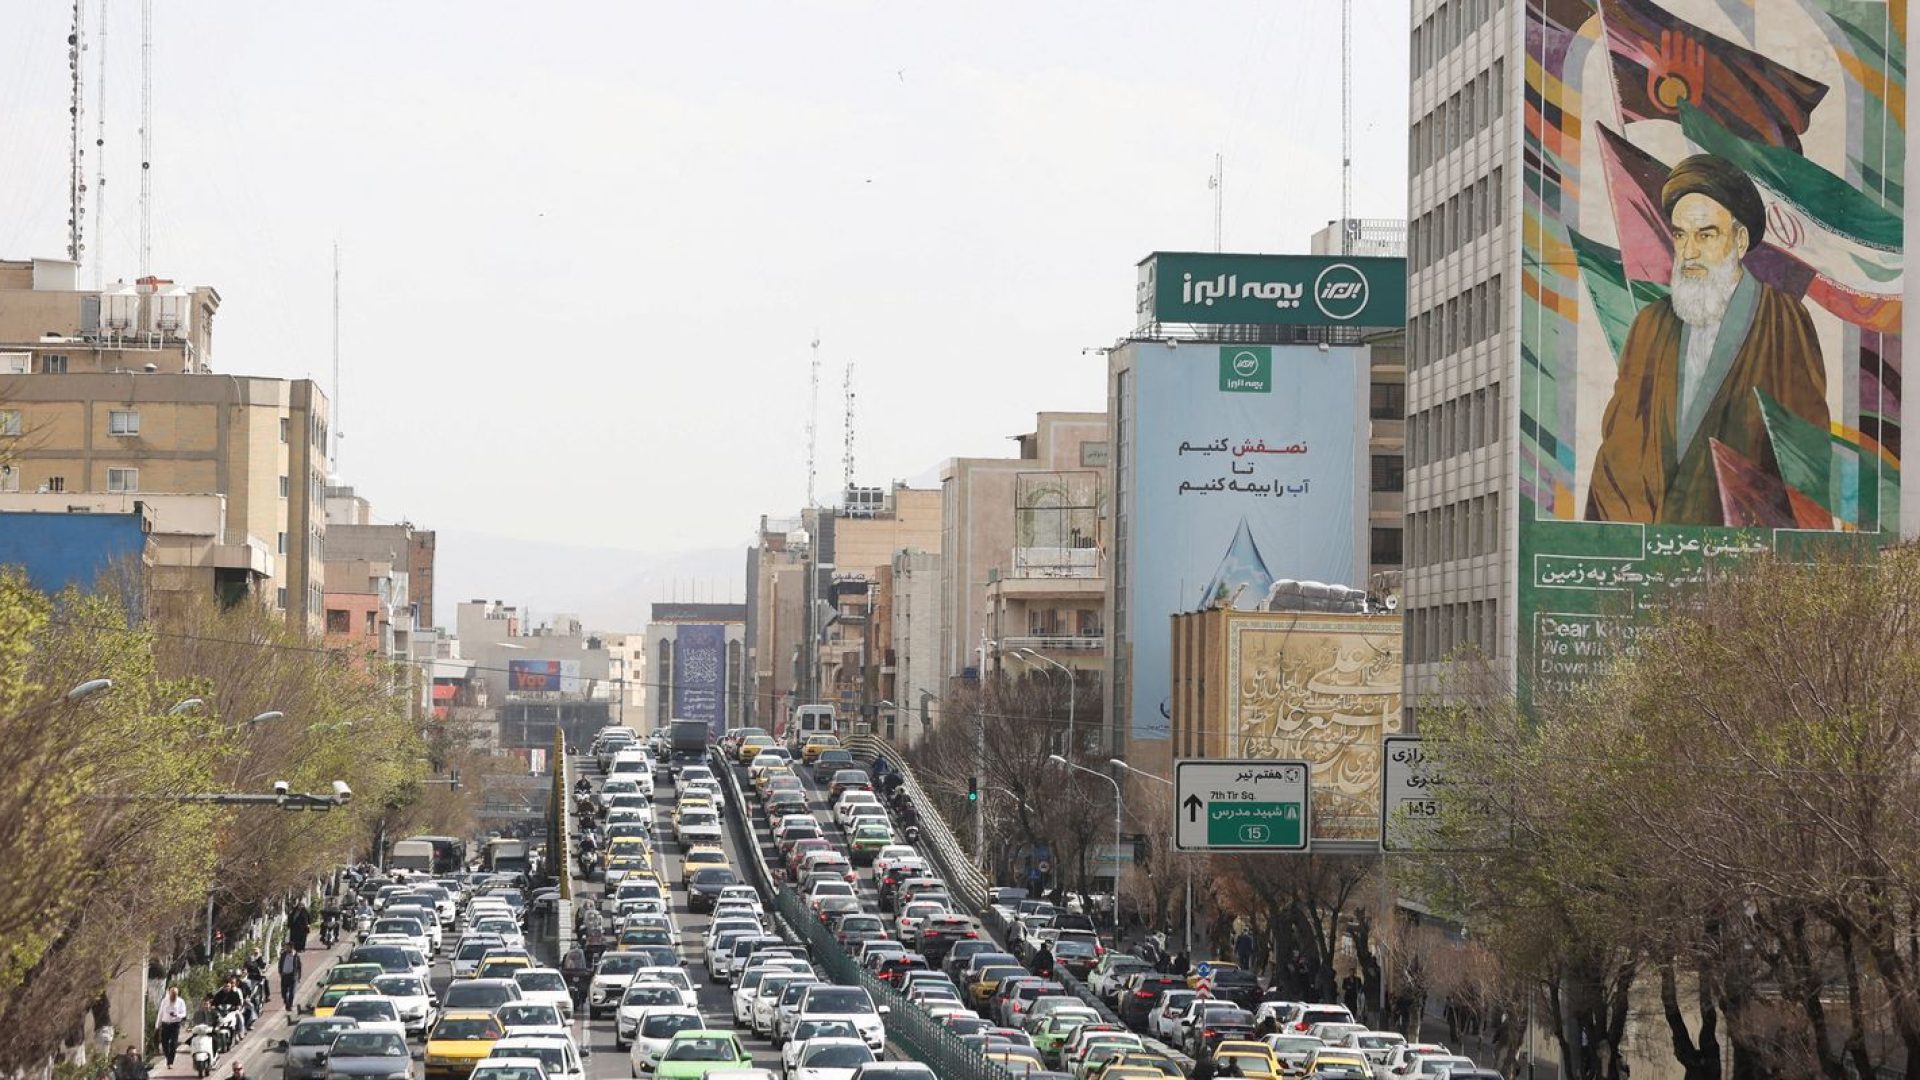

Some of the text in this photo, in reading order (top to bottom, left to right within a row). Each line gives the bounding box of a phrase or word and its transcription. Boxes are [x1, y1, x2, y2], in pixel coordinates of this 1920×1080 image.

[1182, 272, 1237, 306] البرز
[1241, 282, 1304, 308] بیمه
[1179, 438, 1307, 456] نصفش کنیم
[1232, 461, 1254, 474] تا
[1179, 477, 1310, 497] آب را بیمه کنیم
[1541, 563, 1585, 583] زمین
[1587, 566, 1607, 586] به
[1541, 618, 1591, 637] Dear
[1541, 640, 1568, 656] We
[1541, 659, 1588, 674] Down
[1235, 770, 1283, 783] هفتم تیر
[1210, 791, 1256, 801] 7th Tir Sq.
[1212, 806, 1282, 819] شهید مدرس
[1247, 827, 1261, 839] 15
